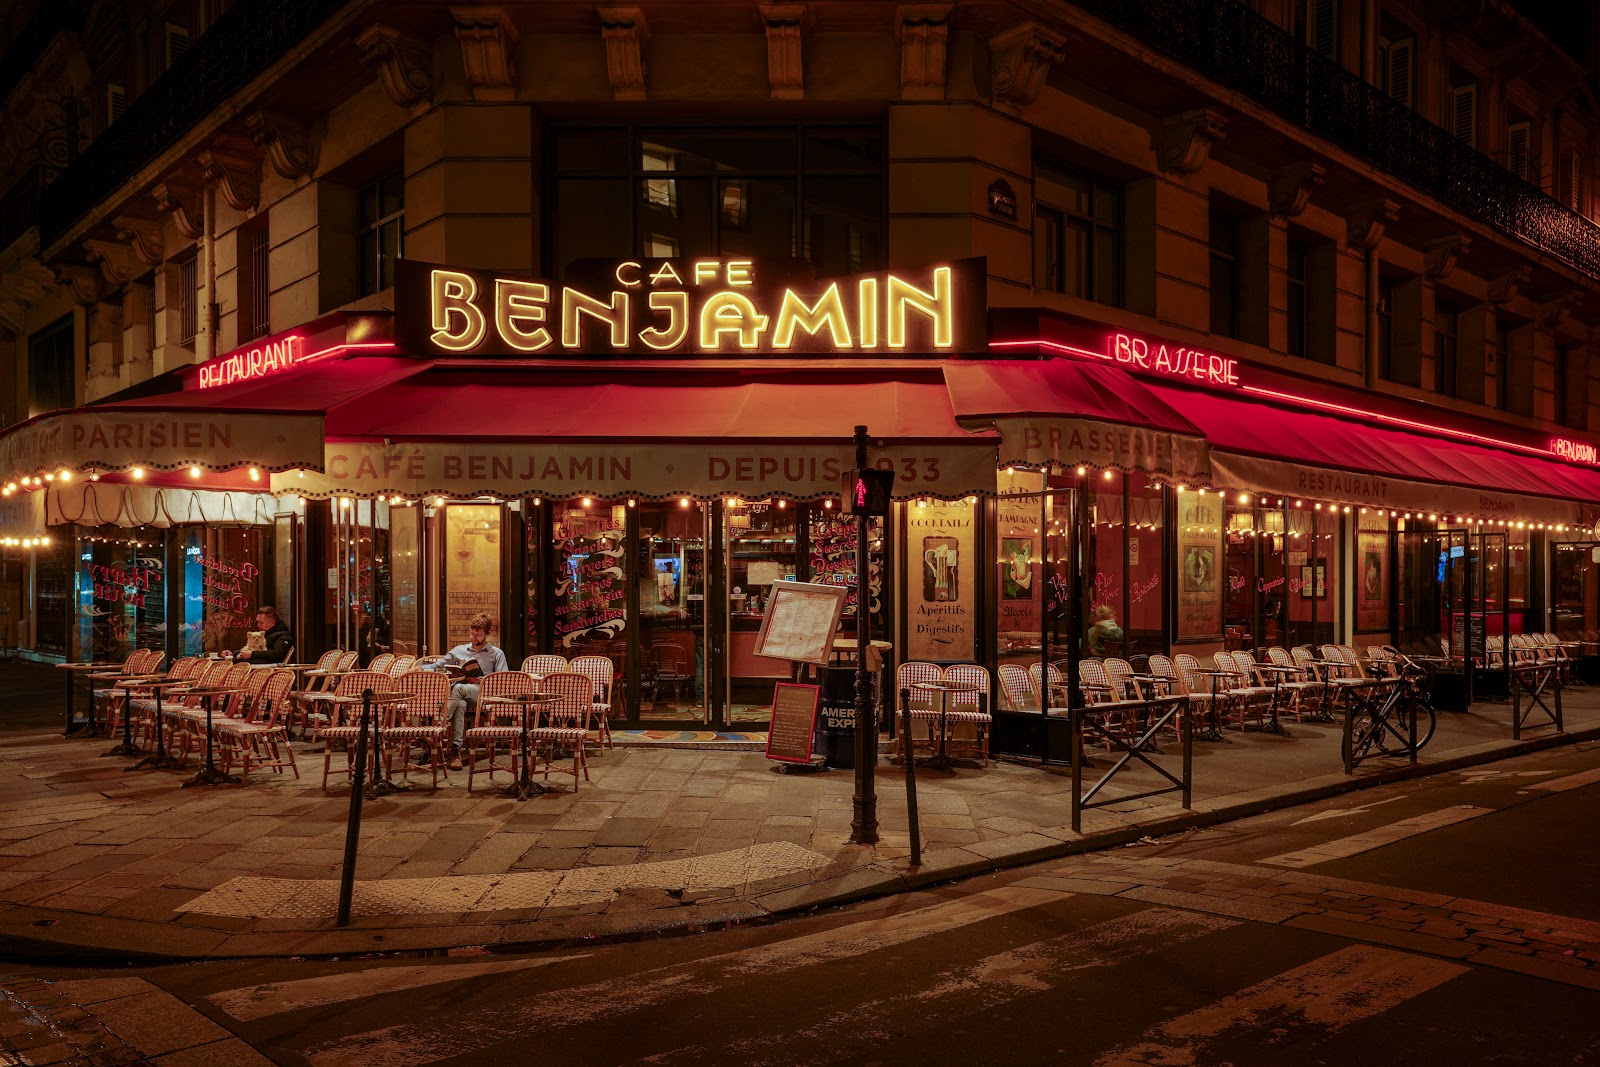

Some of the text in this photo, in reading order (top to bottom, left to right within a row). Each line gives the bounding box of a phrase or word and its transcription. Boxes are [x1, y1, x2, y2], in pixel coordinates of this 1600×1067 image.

[615, 261, 753, 286] CAFE
[430, 266, 953, 352] BENJAMIN
[199, 335, 298, 389] RESTAURANT
[1115, 333, 1240, 386] BRASSERIE
[72, 423, 232, 450] PARISIEN
[1024, 426, 1166, 458] BRASSERIE
[1556, 438, 1597, 464] BENJAMIN
[329, 448, 941, 482] CAFÉ BENJAMIN DEPUIS 933
[1299, 471, 1388, 498] RESTAURANT
[817, 521, 858, 538] Crêpe
[910, 518, 972, 528] COCKTAILS
[999, 514, 1039, 525] HAMPAGNE
[560, 557, 615, 579] Burgers
[554, 608, 624, 635] Sandwiches
[917, 604, 966, 616] Apéritifs
[1002, 605, 1033, 617] Alcools
[916, 624, 965, 636] Digestifs
[821, 706, 856, 718] AMER
